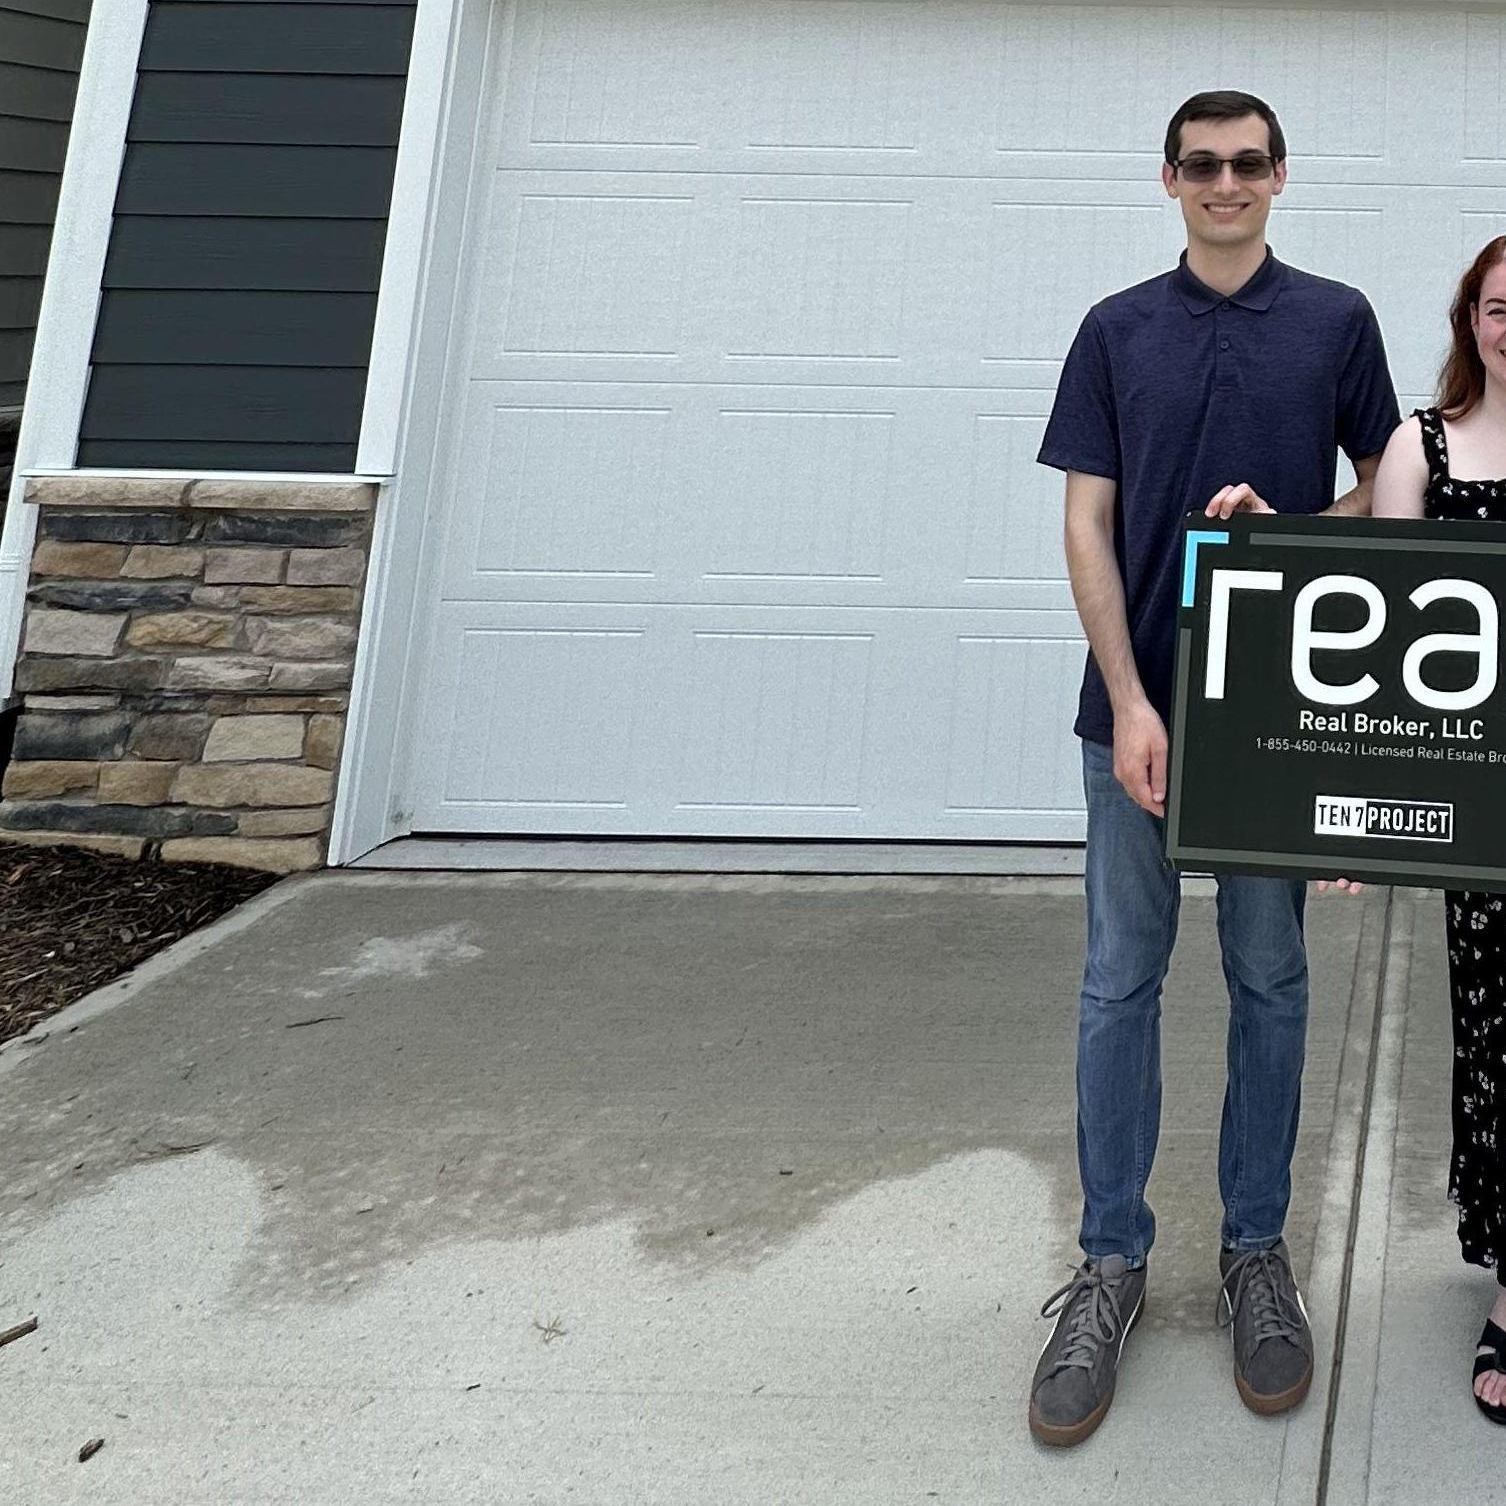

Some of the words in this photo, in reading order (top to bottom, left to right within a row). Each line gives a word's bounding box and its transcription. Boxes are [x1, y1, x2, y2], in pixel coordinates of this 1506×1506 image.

[1299, 709, 1348, 733] Real
[1354, 713, 1435, 740] Broker,
[1442, 717, 1484, 740] LLC
[1256, 737, 1352, 755] 1-855-450-0442
[1361, 742, 1415, 758] Licensed
[1417, 746, 1445, 761] Real
[1447, 748, 1486, 763] Estate
[1367, 806, 1449, 834] PROJECT
